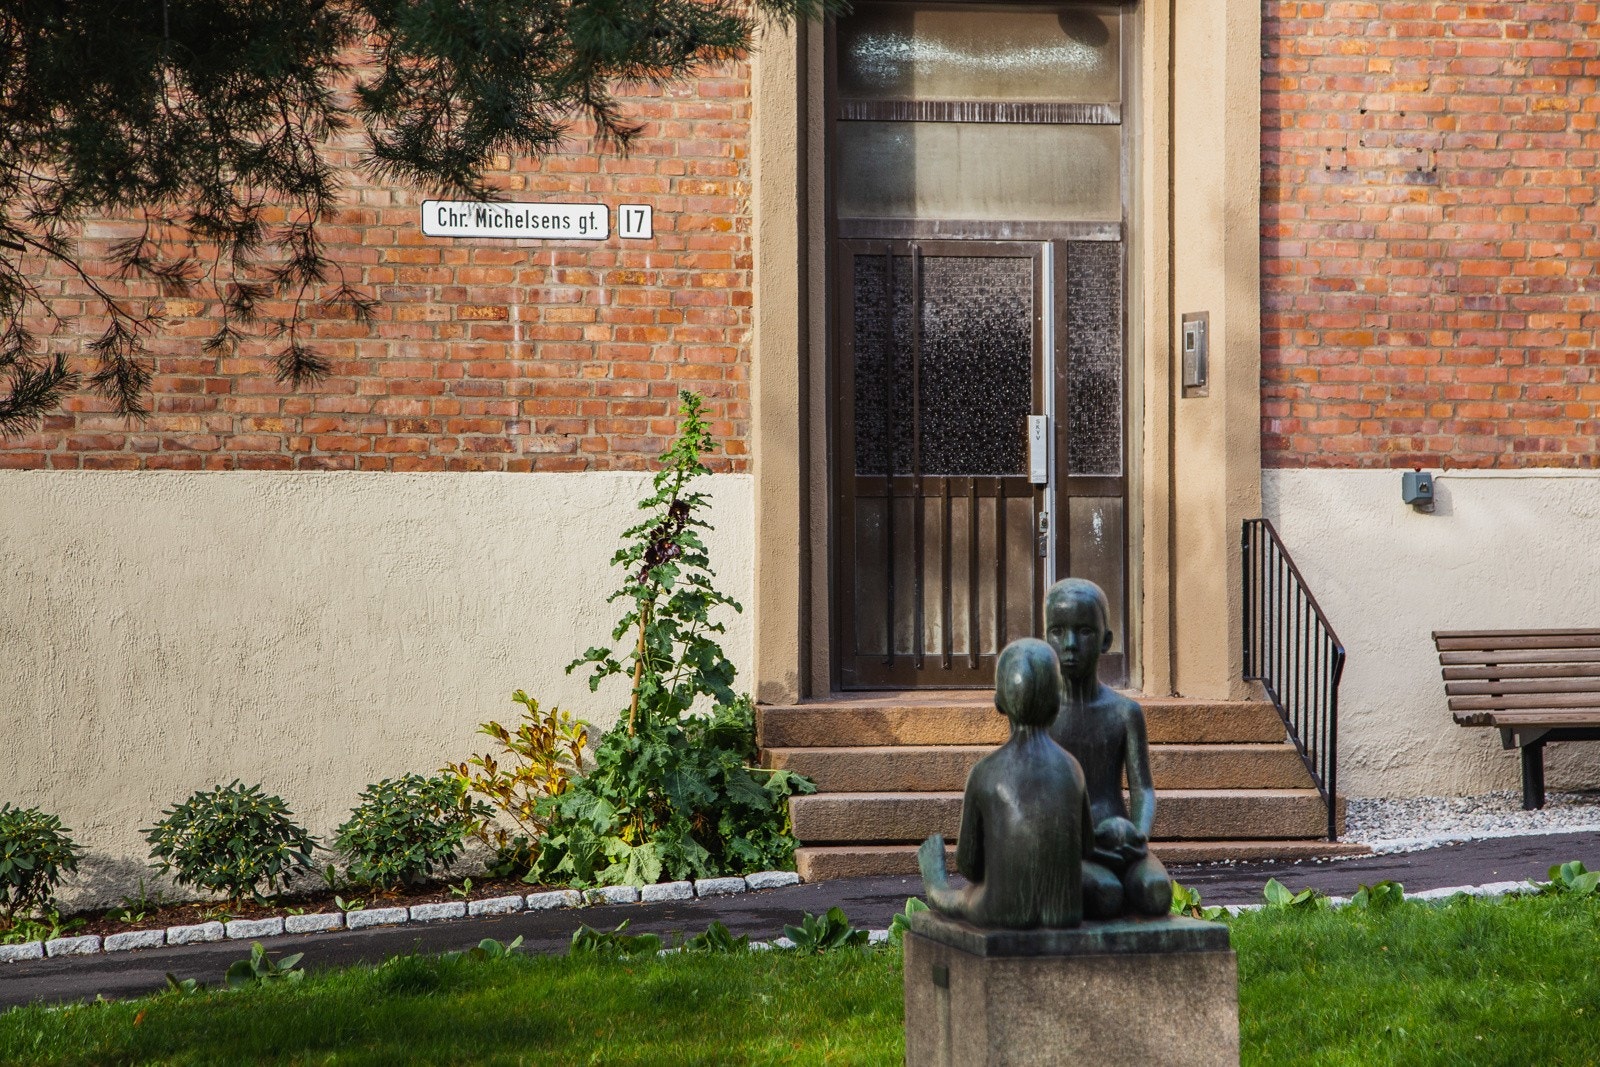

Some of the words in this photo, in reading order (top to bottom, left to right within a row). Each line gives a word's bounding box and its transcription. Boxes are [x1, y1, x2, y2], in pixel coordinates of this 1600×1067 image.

[438, 206, 468, 228] Chr.
[475, 207, 571, 230] Michelsens
[579, 211, 598, 235] gt.
[626, 209, 645, 233] 17
